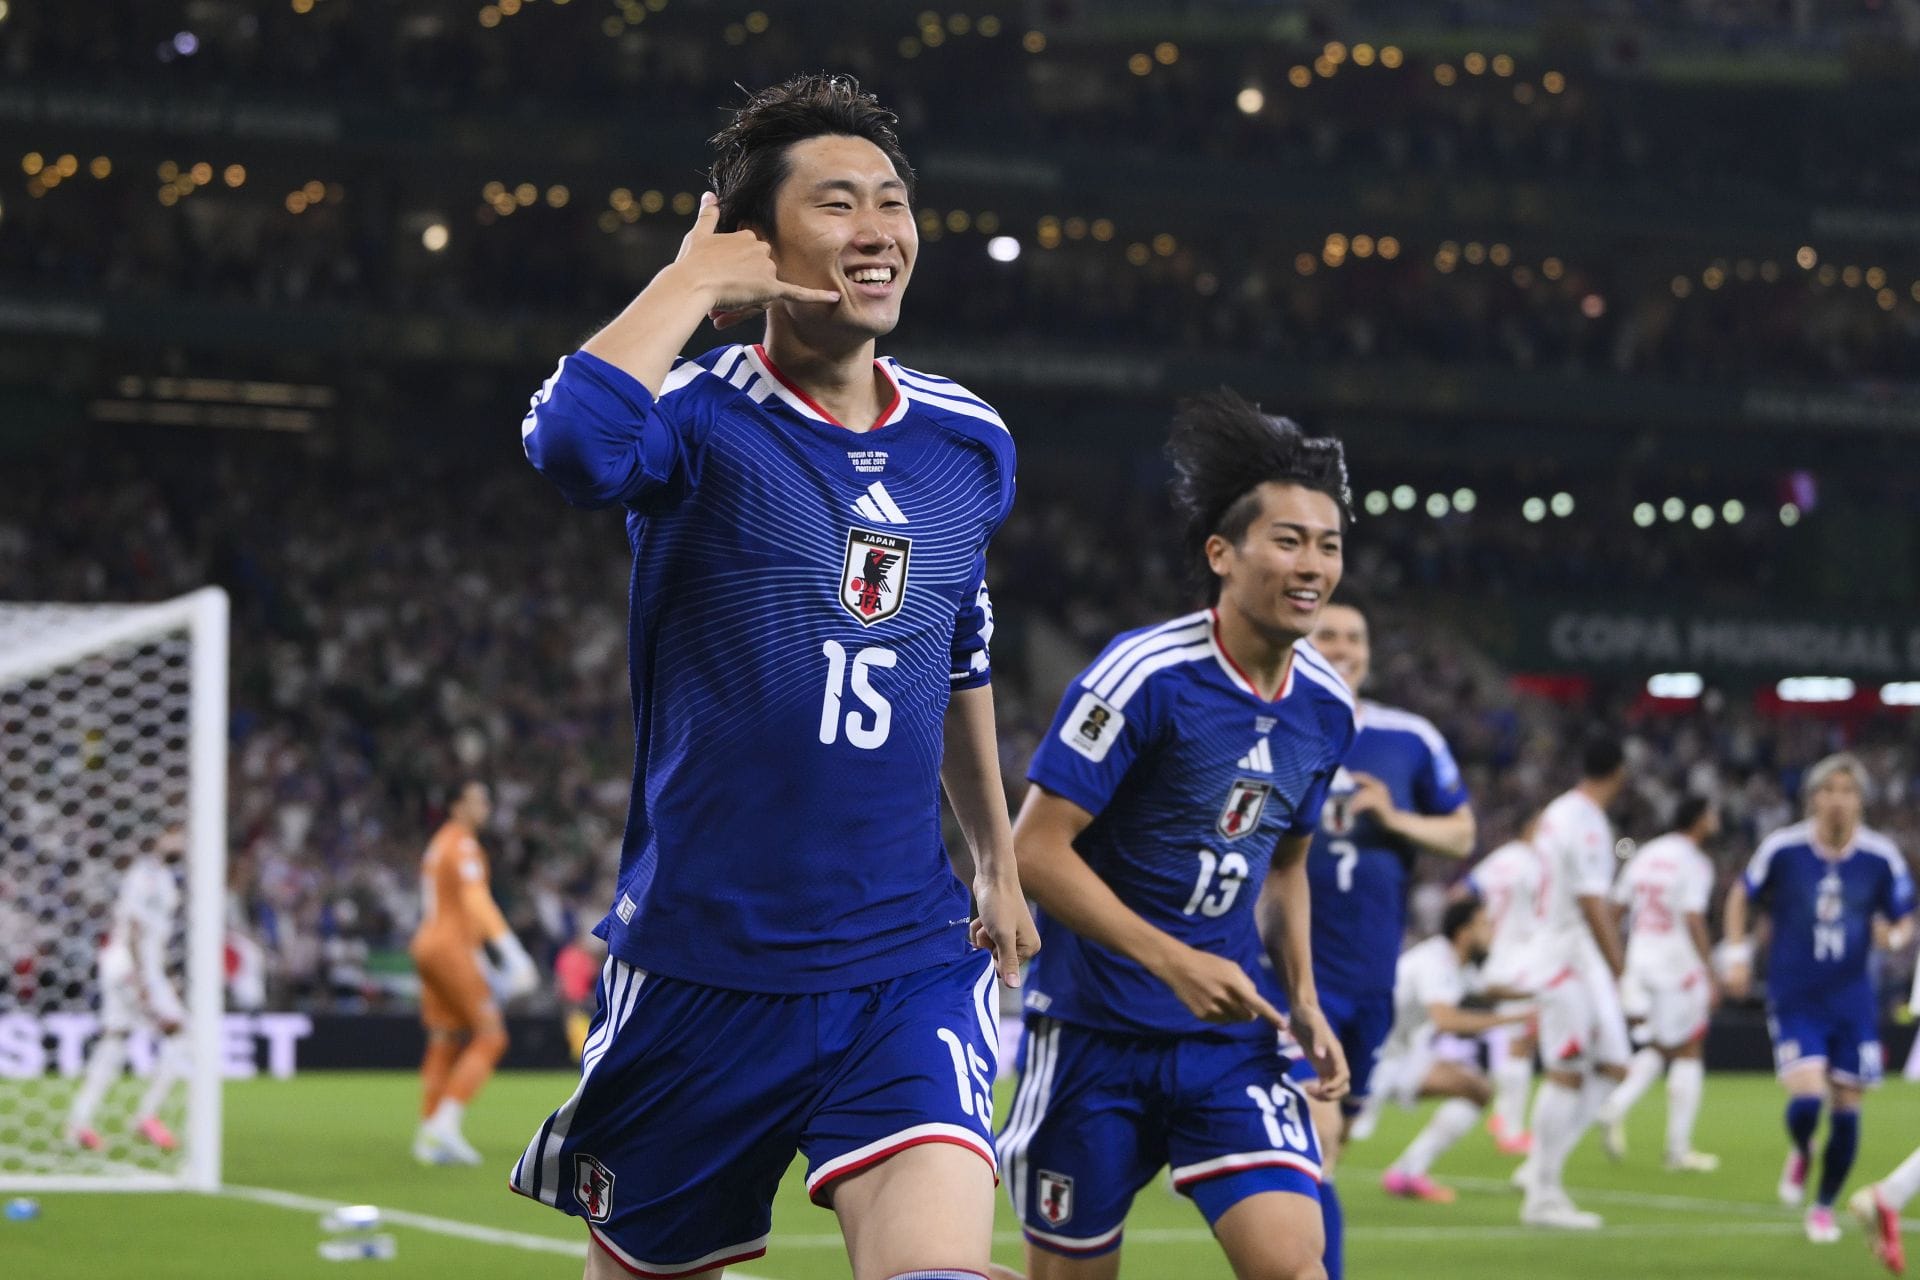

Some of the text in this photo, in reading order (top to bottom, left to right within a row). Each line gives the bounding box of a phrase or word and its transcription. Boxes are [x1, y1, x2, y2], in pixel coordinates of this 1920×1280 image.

[863, 534, 896, 547] JAPAN
[854, 593, 882, 611] JFA
[1550, 612, 1680, 660] COPA
[819, 639, 897, 750] 15
[1183, 850, 1249, 918] 13
[1328, 840, 1358, 893] 7
[0, 1012, 314, 1079] STET
[937, 1027, 994, 1137] 15
[1246, 1083, 1309, 1152] 13
